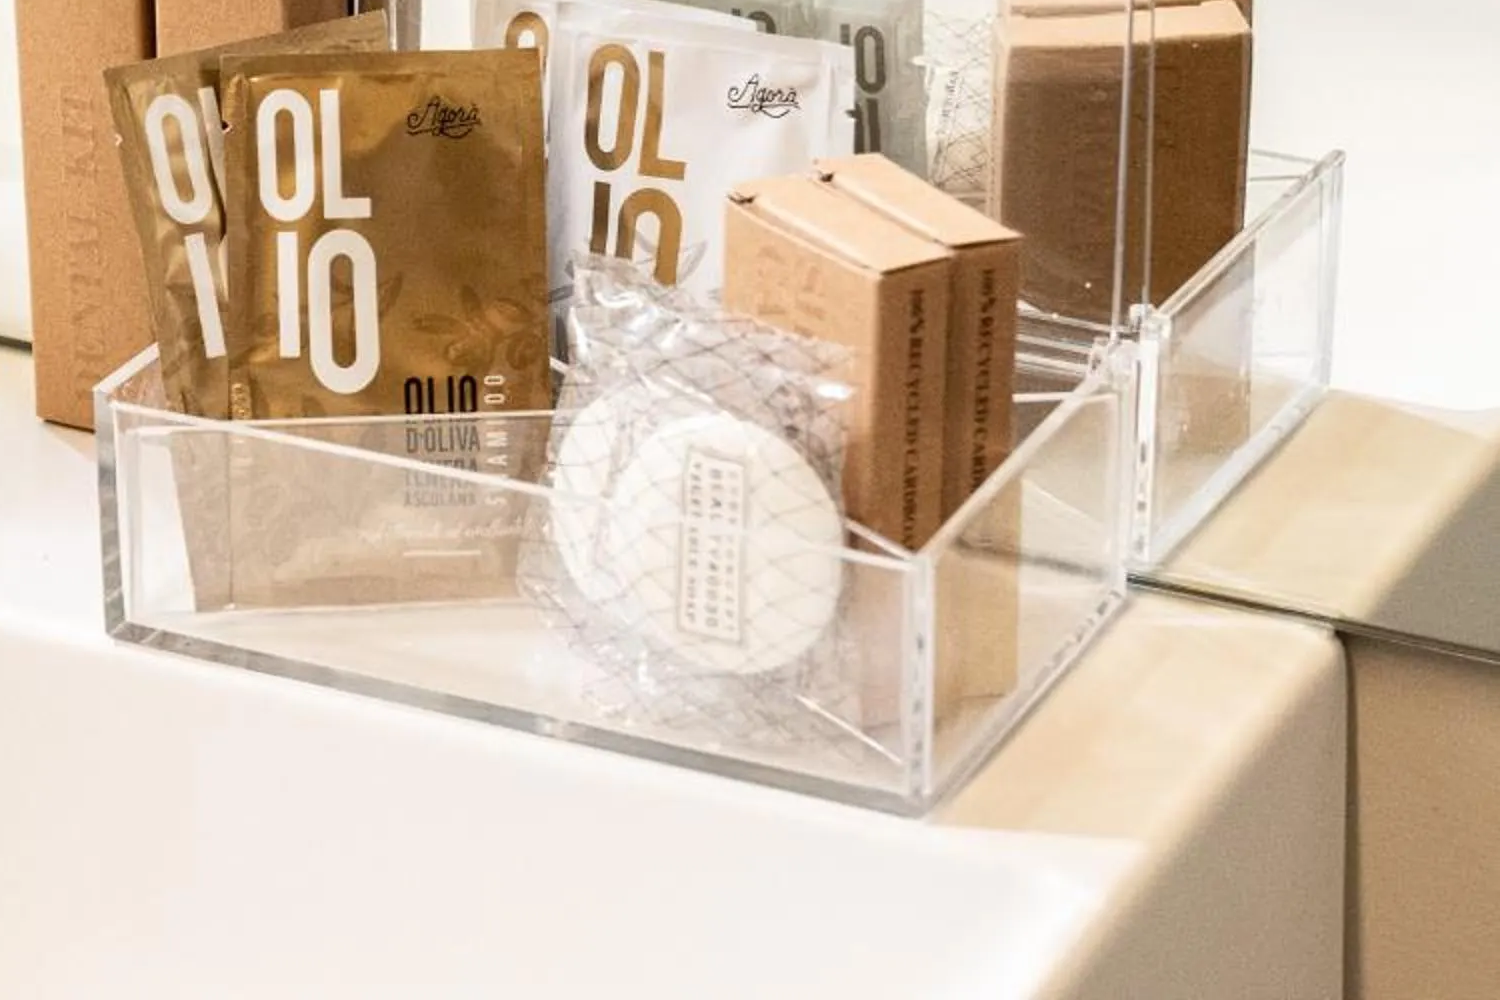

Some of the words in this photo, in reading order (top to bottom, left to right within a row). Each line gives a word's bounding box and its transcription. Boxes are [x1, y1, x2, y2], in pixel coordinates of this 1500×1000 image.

[256, 88, 372, 221] OL
[584, 43, 687, 180] OL
[276, 228, 381, 394] IO
[404, 375, 478, 424] OLIO
[405, 424, 481, 454] D'OLIVA
